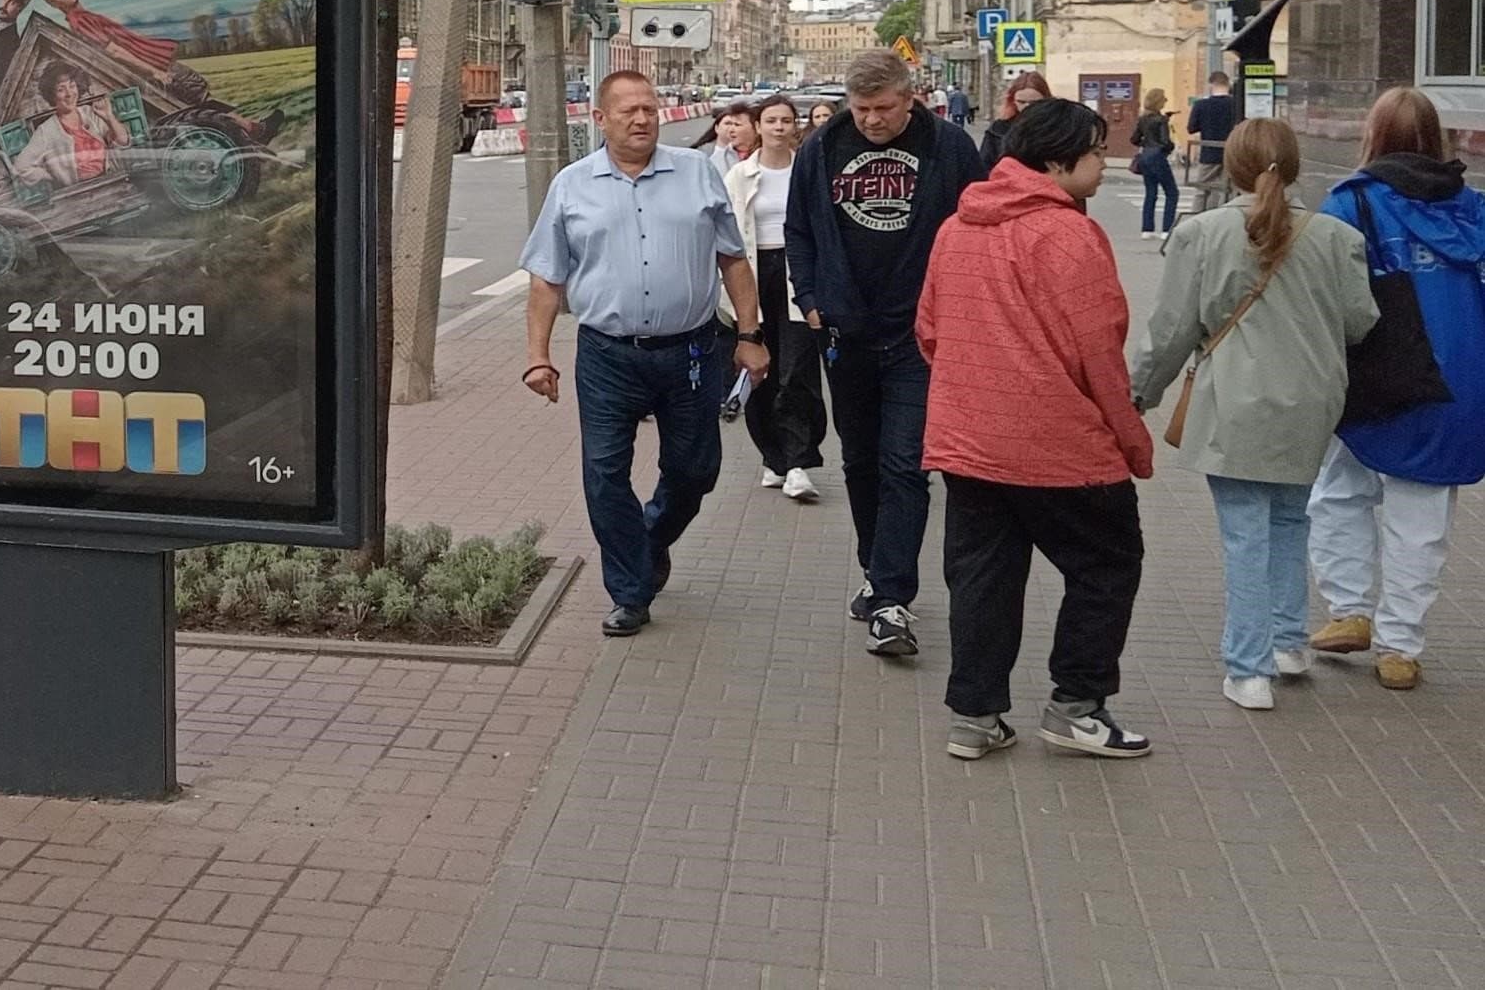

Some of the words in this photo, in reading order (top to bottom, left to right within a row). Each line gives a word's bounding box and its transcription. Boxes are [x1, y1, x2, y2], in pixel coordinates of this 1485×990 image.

[868, 162, 906, 175] THOR
[7, 302, 61, 333] 24
[74, 303, 205, 336] ИЮНЯ
[13, 339, 160, 380] 20:00
[248, 456, 295, 484] 16+
